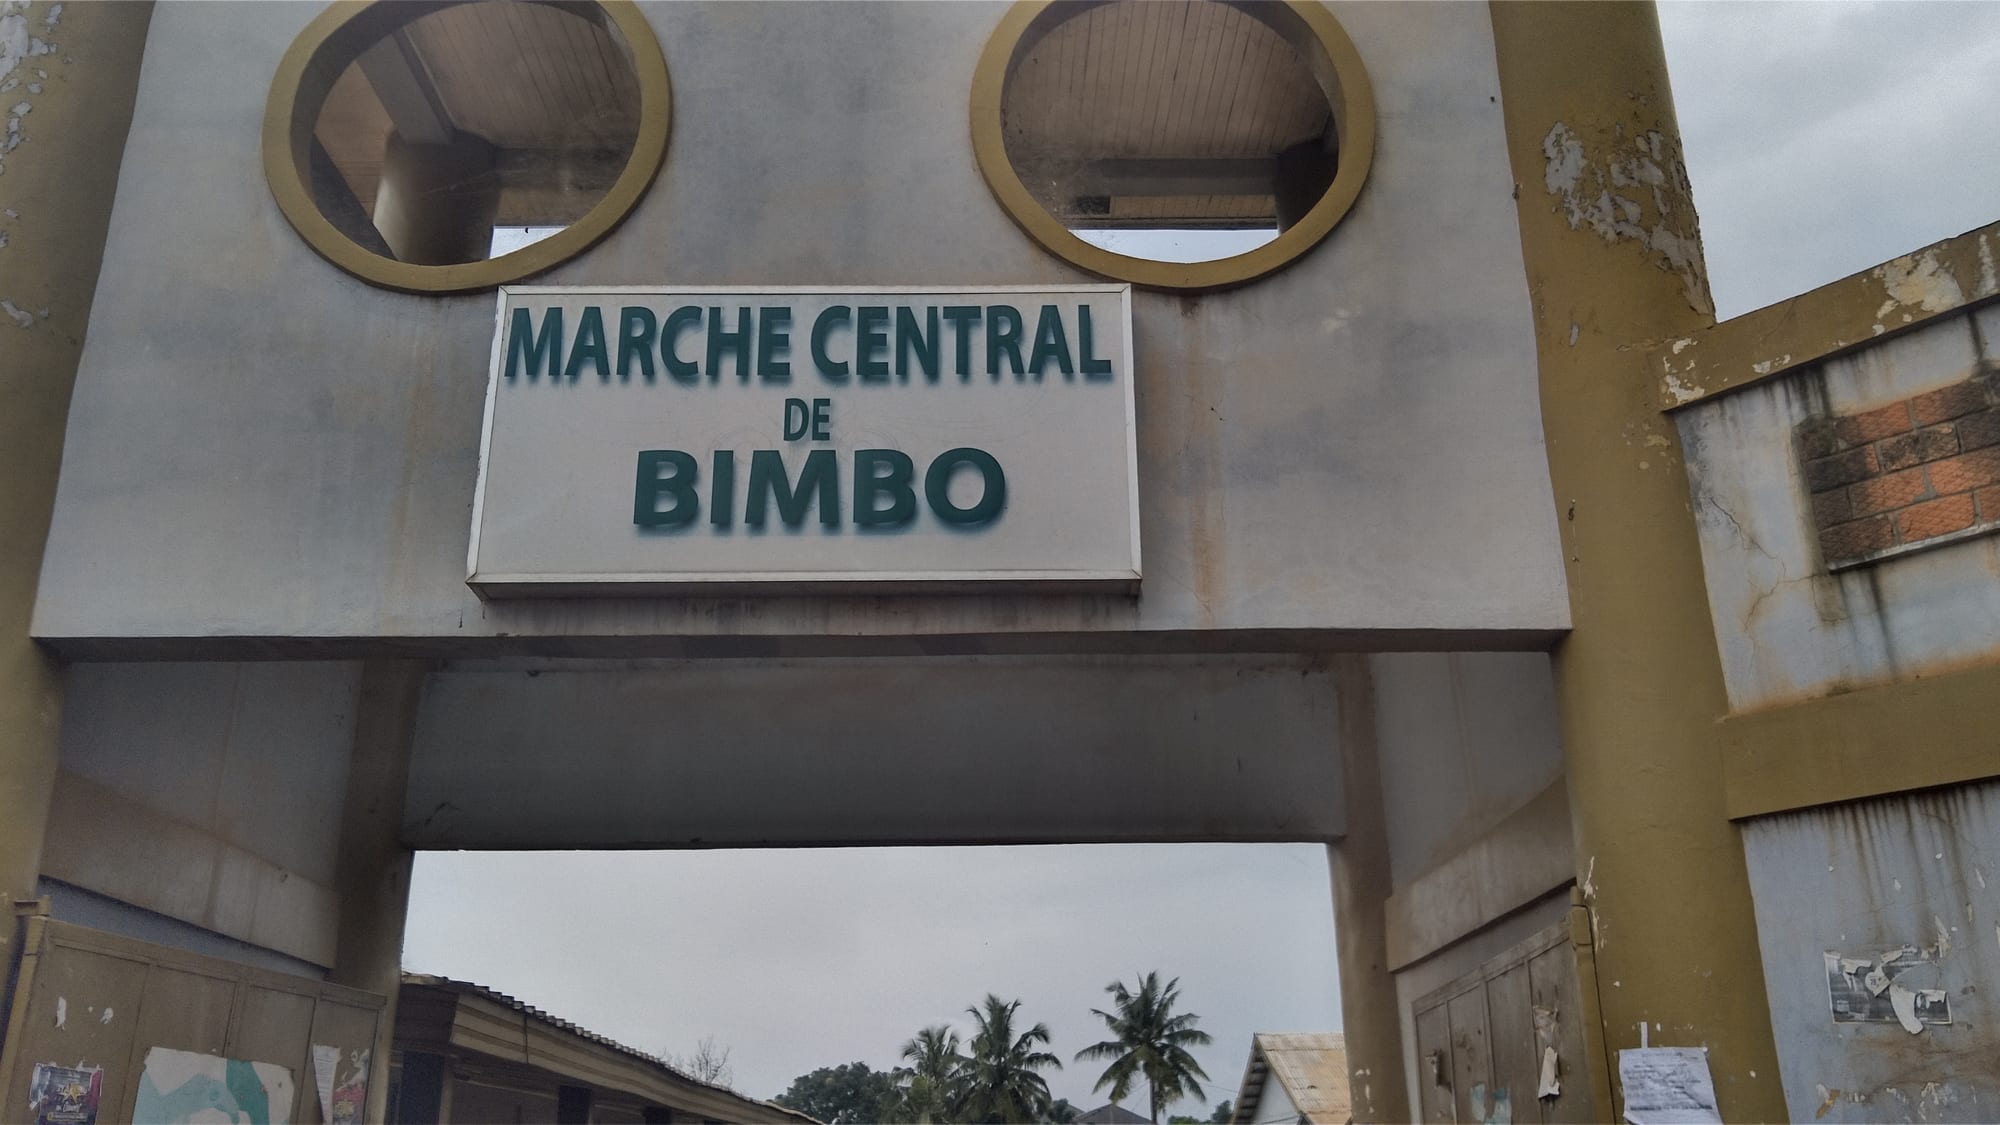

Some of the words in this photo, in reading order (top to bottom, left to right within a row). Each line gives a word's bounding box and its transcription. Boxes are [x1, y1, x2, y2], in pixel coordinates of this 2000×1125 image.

[504, 306, 792, 378] MARCHE
[810, 304, 1112, 377] CENTRAL
[783, 398, 831, 441] DE
[633, 447, 1006, 525] BIMBO
